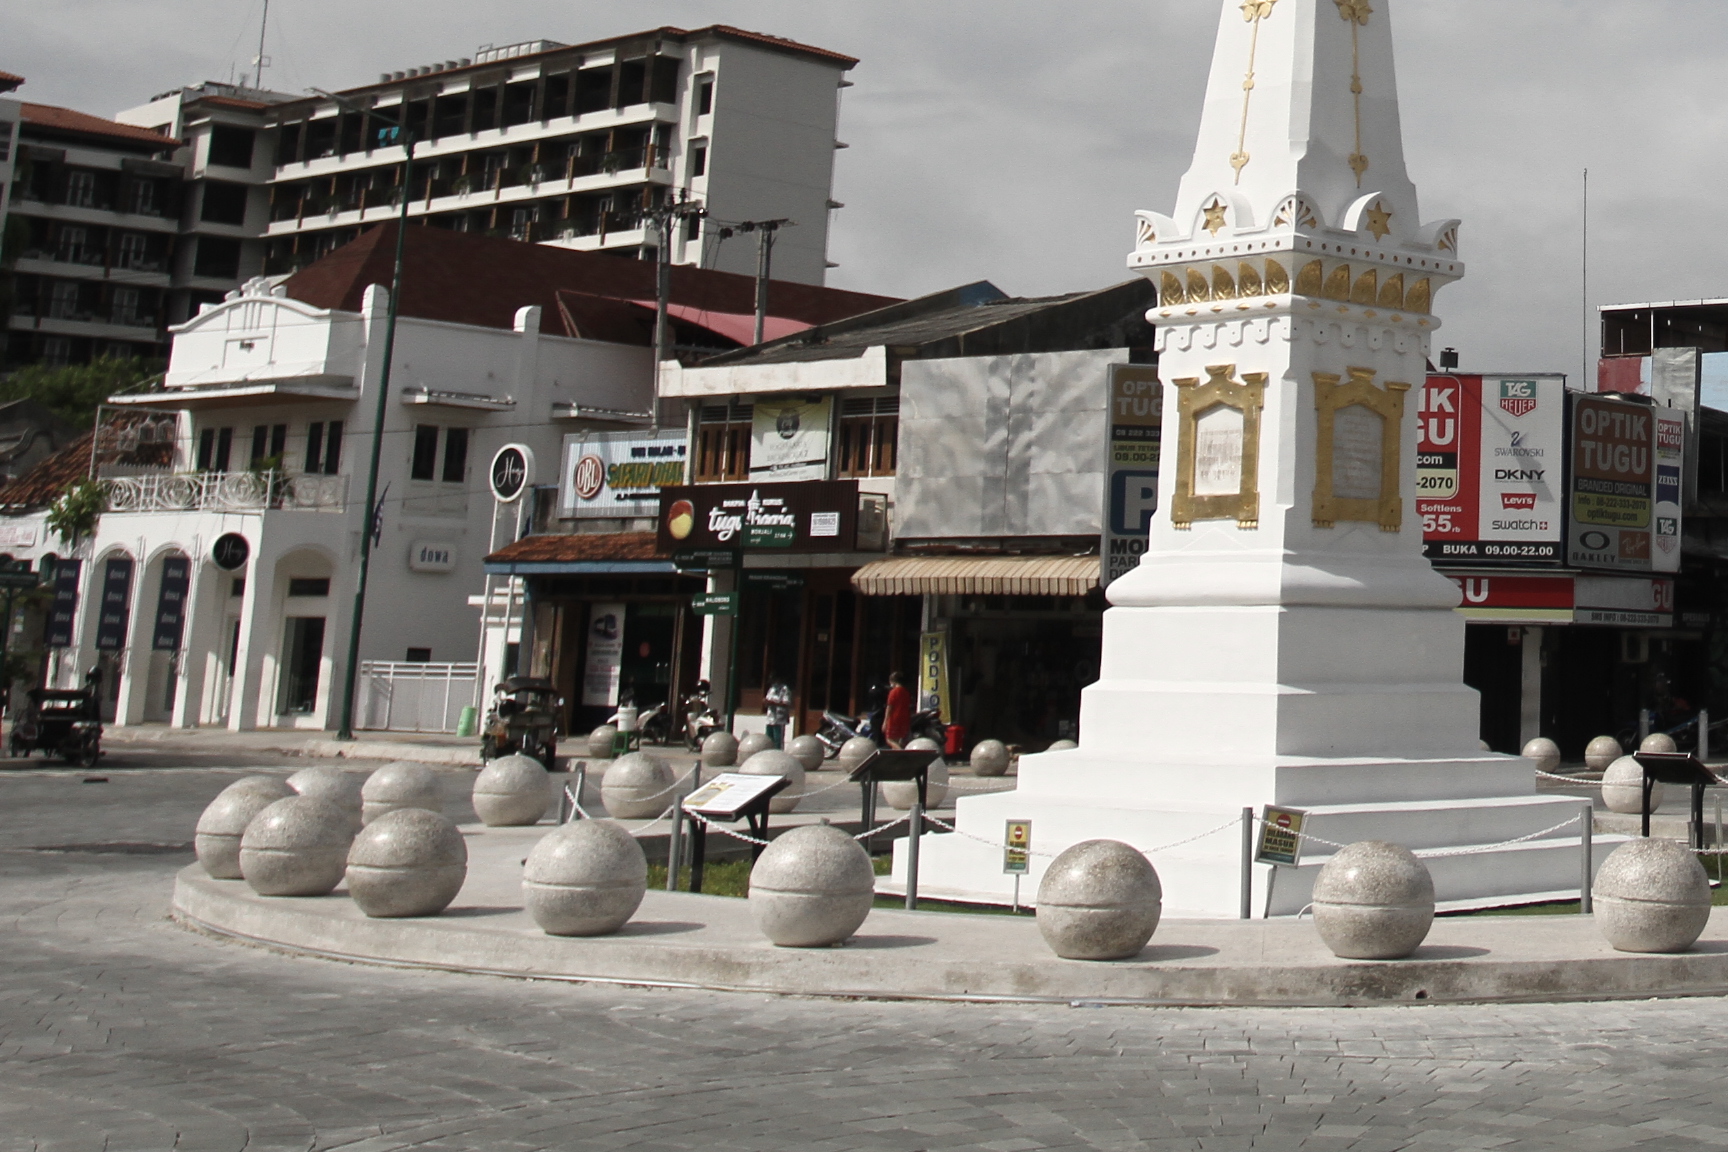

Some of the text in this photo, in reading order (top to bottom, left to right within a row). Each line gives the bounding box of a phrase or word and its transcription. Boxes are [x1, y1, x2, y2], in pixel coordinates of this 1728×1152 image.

[1505, 381, 1531, 397] TAG
[1501, 399, 1535, 416] HEUER
[1581, 408, 1647, 441] OPTIK
[1657, 423, 1681, 435] OPTIK
[1417, 418, 1455, 446] U
[1657, 434, 1681, 445] TUGU
[1114, 452, 1160, 462] 09.00-2
[1494, 448, 1544, 458] SWAROVSKI
[1581, 440, 1647, 474] TUGU
[1495, 469, 1546, 480] DKNY
[1658, 475, 1678, 486] ZEISS
[1577, 478, 1647, 496] BRANDED ORIGINAL
[1421, 503, 1462, 513] Softlens
[1492, 519, 1538, 530] swatch
[420, 546, 449, 564] dowa
[1443, 545, 1478, 555] BUKA
[1485, 545, 1553, 556] 09.00-22.00
[1110, 556, 1140, 567] PAR
[1572, 552, 1616, 563] OAKLEY
[929, 637, 940, 707] PODJO
[1265, 837, 1295, 848] MASUK
